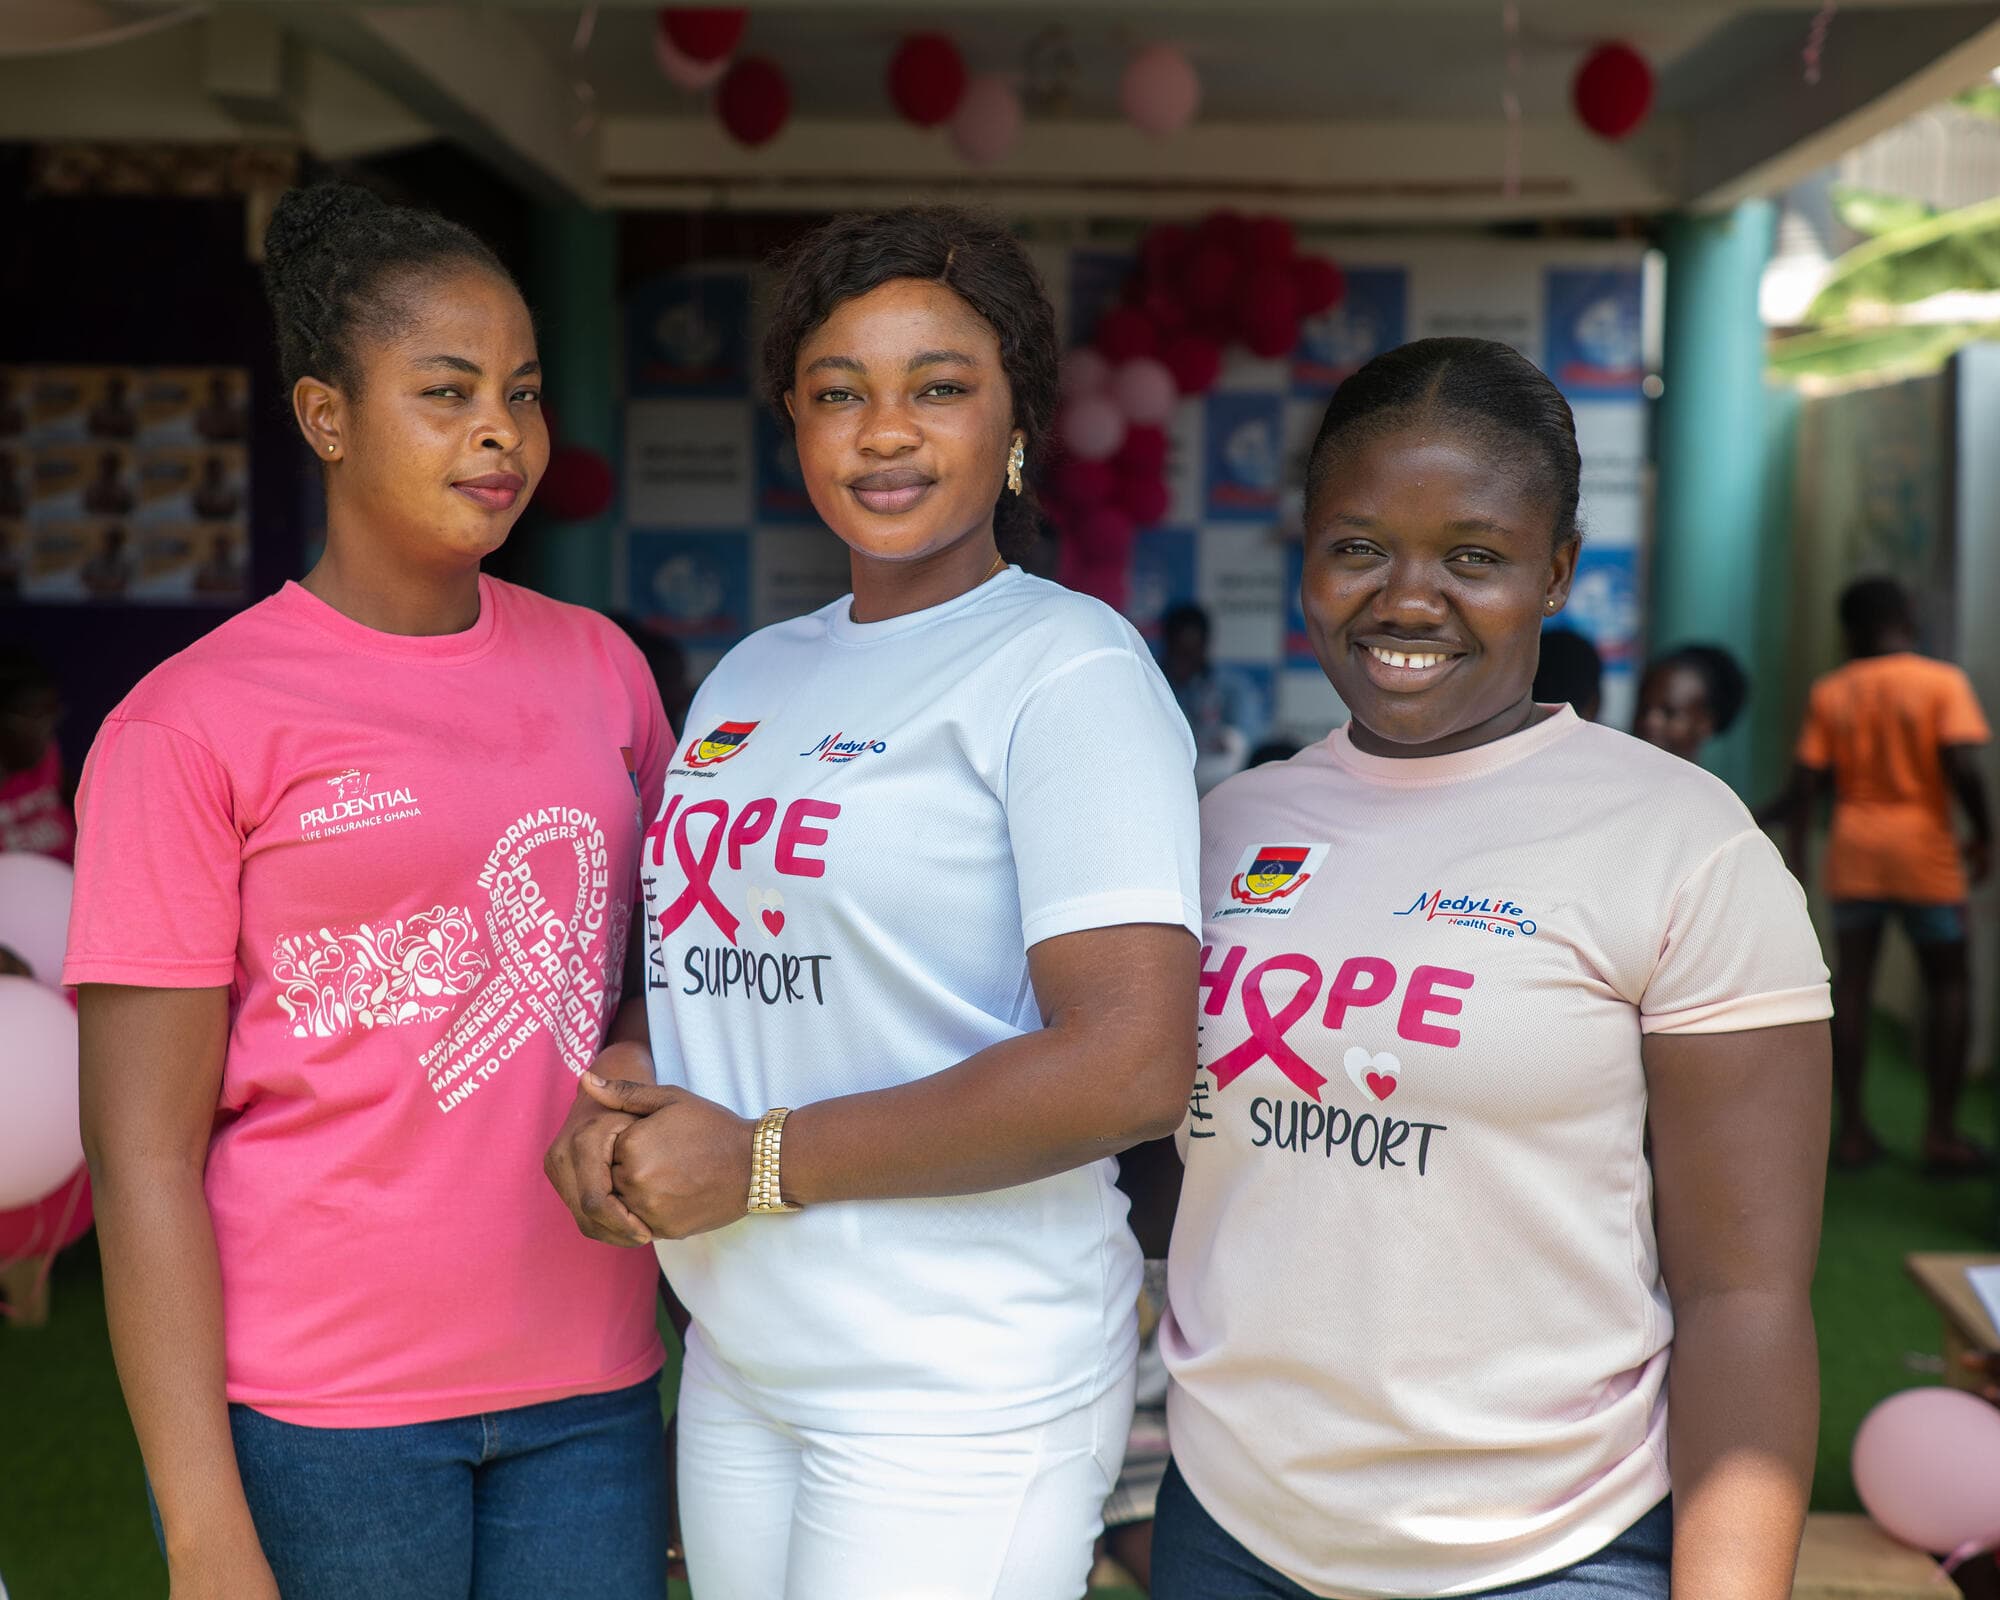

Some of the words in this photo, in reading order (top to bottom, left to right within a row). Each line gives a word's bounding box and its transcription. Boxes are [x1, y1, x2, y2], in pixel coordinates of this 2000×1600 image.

[299, 787, 418, 831] PRUDENTIAL
[691, 770, 718, 778] Hospital
[301, 830, 321, 842] LIFE
[324, 815, 382, 837] INSURANCE
[384, 807, 421, 823] GHANA
[477, 806, 597, 889] INFORMATION
[507, 825, 578, 868] BARRIERS
[569, 837, 589, 932] OVERCOME
[577, 829, 608, 954] ACCESS
[1223, 907, 1254, 916] Military
[1254, 906, 1291, 915] Hospital
[1393, 889, 1523, 921] MedyLife
[1448, 918, 1515, 938] HealthCare
[489, 888, 510, 929] SELF
[503, 928, 551, 992] BREAST
[545, 990, 595, 1066] EXAMINA
[496, 871, 536, 938] CURE
[529, 939, 600, 1050] PREVENT
[511, 861, 575, 954] POLICY
[568, 954, 604, 1018] CHA
[683, 946, 832, 1005] SUPPORT
[418, 1030, 452, 1067] EARLY
[453, 972, 507, 1031] DETECTION
[428, 983, 515, 1081] AWARENESS
[485, 911, 504, 956] CREATE
[500, 956, 530, 993] EARLY
[526, 994, 567, 1055] DETECTION
[563, 1052, 586, 1077] CEN
[431, 999, 525, 1093] MANAGEMENT
[437, 1076, 480, 1114] LINK
[475, 1057, 501, 1081] TO
[498, 1016, 541, 1060] CARE
[1249, 1096, 1448, 1176] SUPPORT
